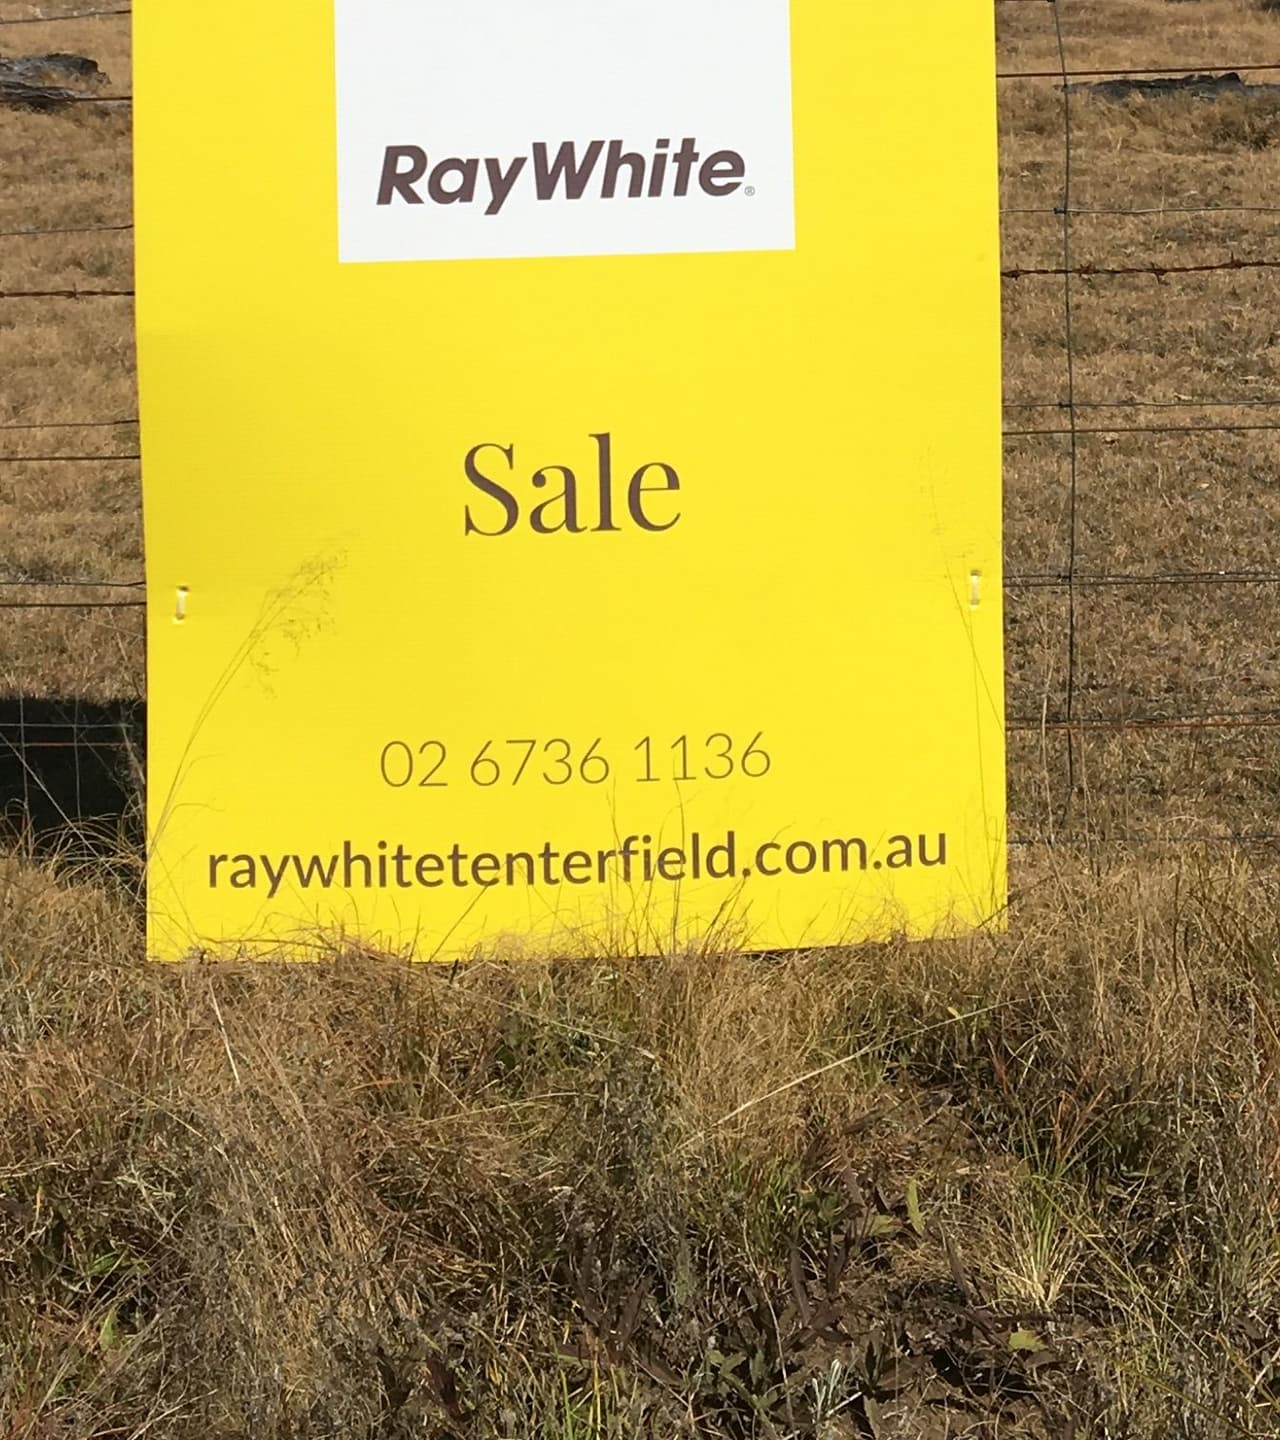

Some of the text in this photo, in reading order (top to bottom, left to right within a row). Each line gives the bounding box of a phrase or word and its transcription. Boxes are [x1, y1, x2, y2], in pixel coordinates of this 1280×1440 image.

[464, 432, 681, 537] Sale
[380, 731, 771, 787] 02 6736 1136
[208, 831, 948, 898] raywhitetenterfield.com.au
